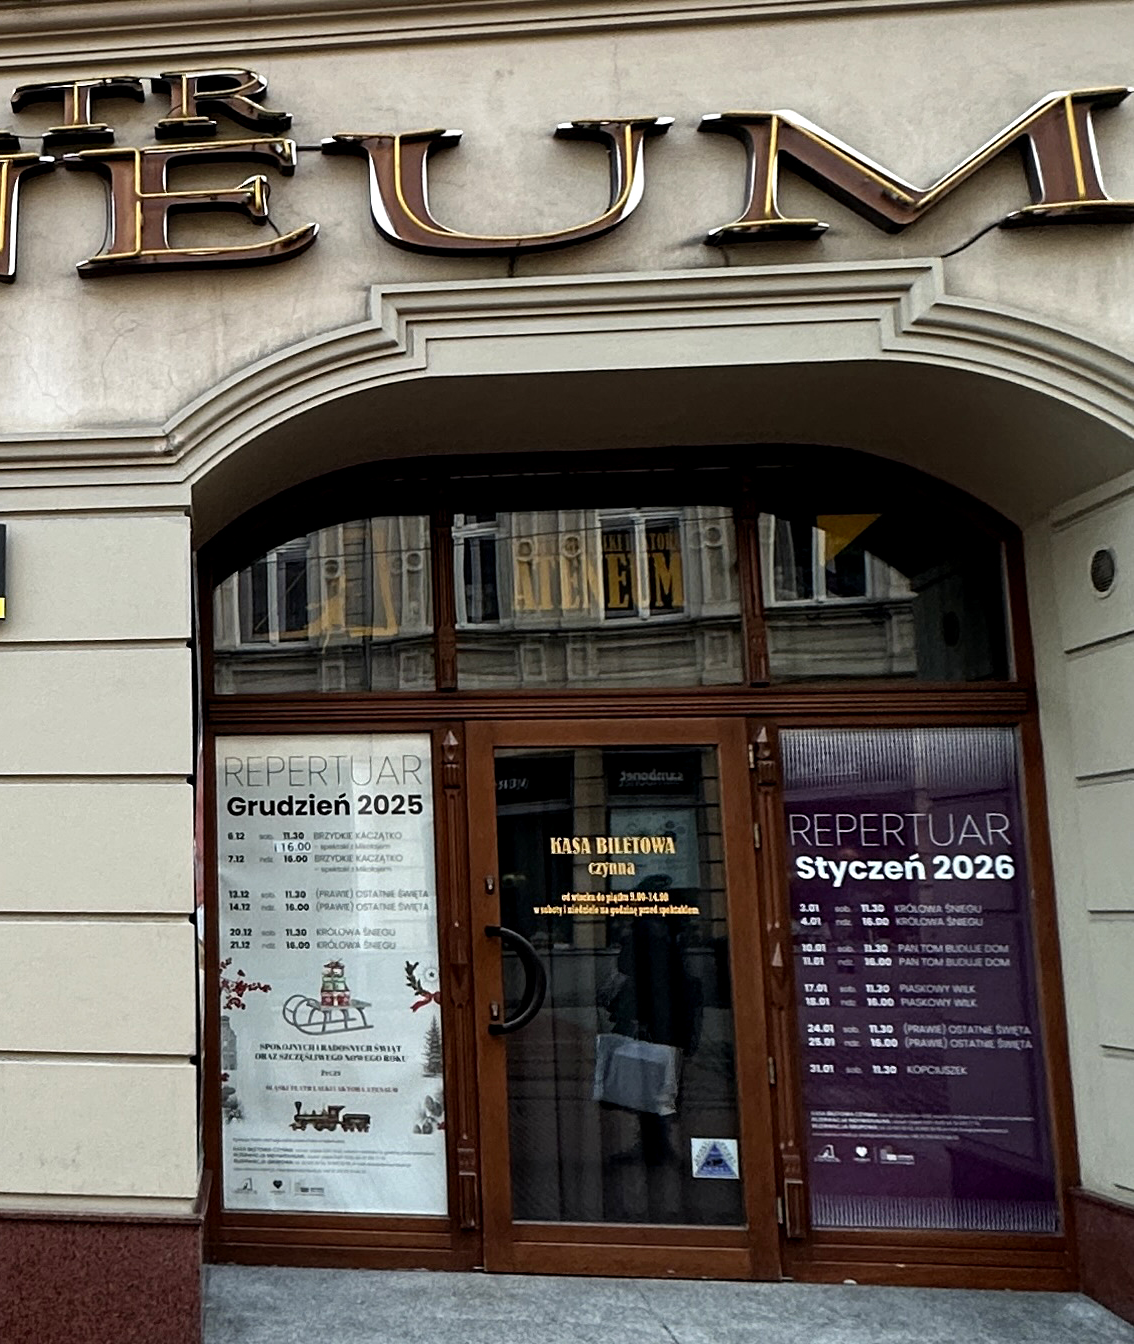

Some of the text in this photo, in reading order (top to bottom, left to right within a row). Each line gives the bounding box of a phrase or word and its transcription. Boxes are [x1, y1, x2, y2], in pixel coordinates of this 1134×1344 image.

[224, 754, 423, 787] REPERTUAR
[227, 793, 423, 816] Grudzień 2025
[789, 813, 1012, 847] REPERTUAR
[283, 832, 304, 840] 11.30
[355, 831, 402, 841] KACZĄTKO
[282, 842, 311, 851] 16.00
[550, 837, 675, 855] KASA BILETOWA
[228, 855, 245, 863] 7.12
[356, 854, 403, 864] KACZĄTKO
[588, 862, 635, 878] czynna
[796, 854, 1015, 887] Styczeń 2026
[229, 903, 251, 911] 14.12
[894, 903, 942, 913] KRÓLOWA
[800, 917, 821, 925] 4.01
[896, 916, 945, 926] KRÓLOWA
[230, 928, 252, 936] 20.12
[898, 944, 919, 953] PAN
[921, 944, 943, 953] TOM
[984, 944, 1009, 953] DOM
[899, 957, 919, 966] PAN
[922, 958, 944, 966] TOM
[985, 958, 1011, 966] DOM
[807, 1024, 834, 1033] 24.01
